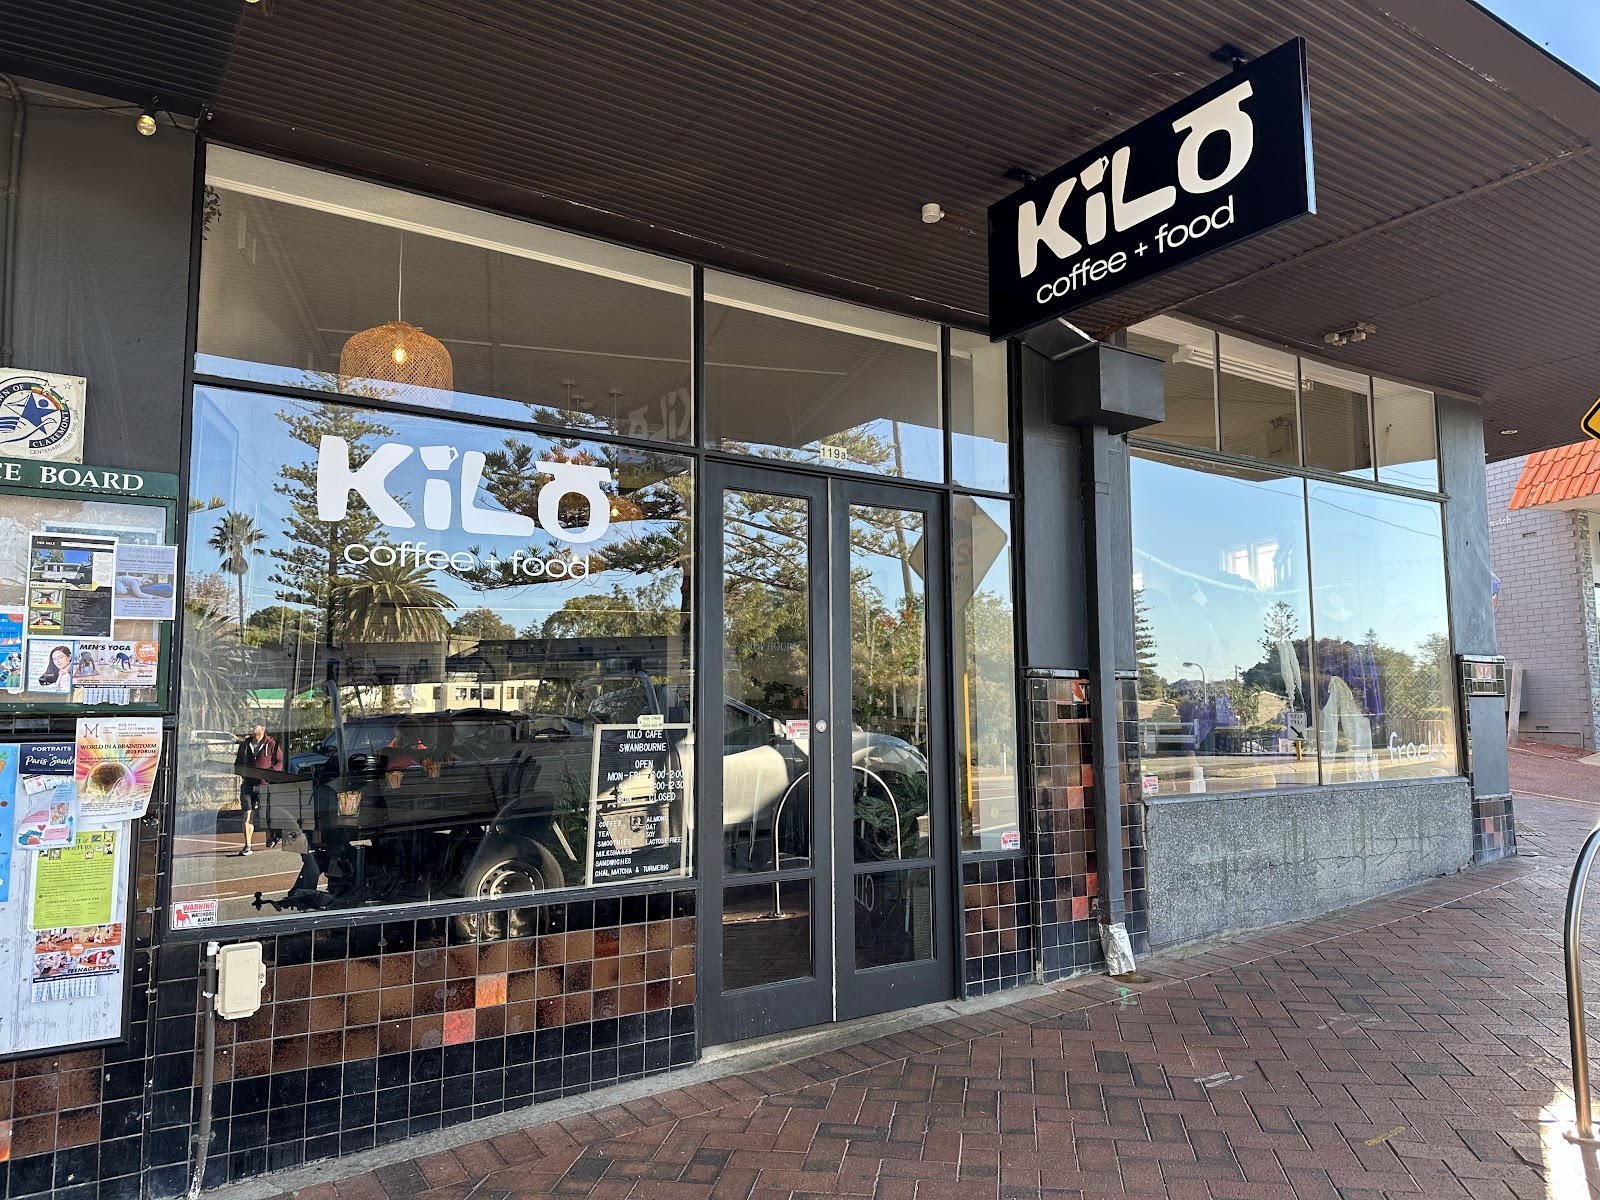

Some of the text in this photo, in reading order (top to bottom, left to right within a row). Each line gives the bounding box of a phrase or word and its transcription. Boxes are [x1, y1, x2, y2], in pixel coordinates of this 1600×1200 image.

[1036, 195, 1235, 304] coffee + food
[32, 411, 70, 448] CLAREMONT
[821, 447, 846, 460] 119a
[40, 466, 144, 491] BOARD
[343, 541, 474, 572] coffee
[510, 549, 589, 580] food
[626, 729, 663, 739] KILO CAFE
[618, 742, 667, 752] SWANBOURNE
[25, 755, 48, 766] Paris
[634, 759, 654, 769] OPEN
[648, 791, 677, 802] CLOSED
[598, 820, 622, 828] COFFEE
[645, 815, 669, 823] ALMOND
[597, 838, 631, 848] SMOOTHIES
[645, 836, 682, 846] LACTOSE FREE
[595, 848, 632, 858] MILKSHAKES
[595, 858, 632, 868] SANDWICHES
[610, 867, 633, 876] MATCHA
[642, 863, 670, 873] TURMERIC
[182, 902, 215, 911] WARNING
[67, 965, 96, 974] TEENAGE
